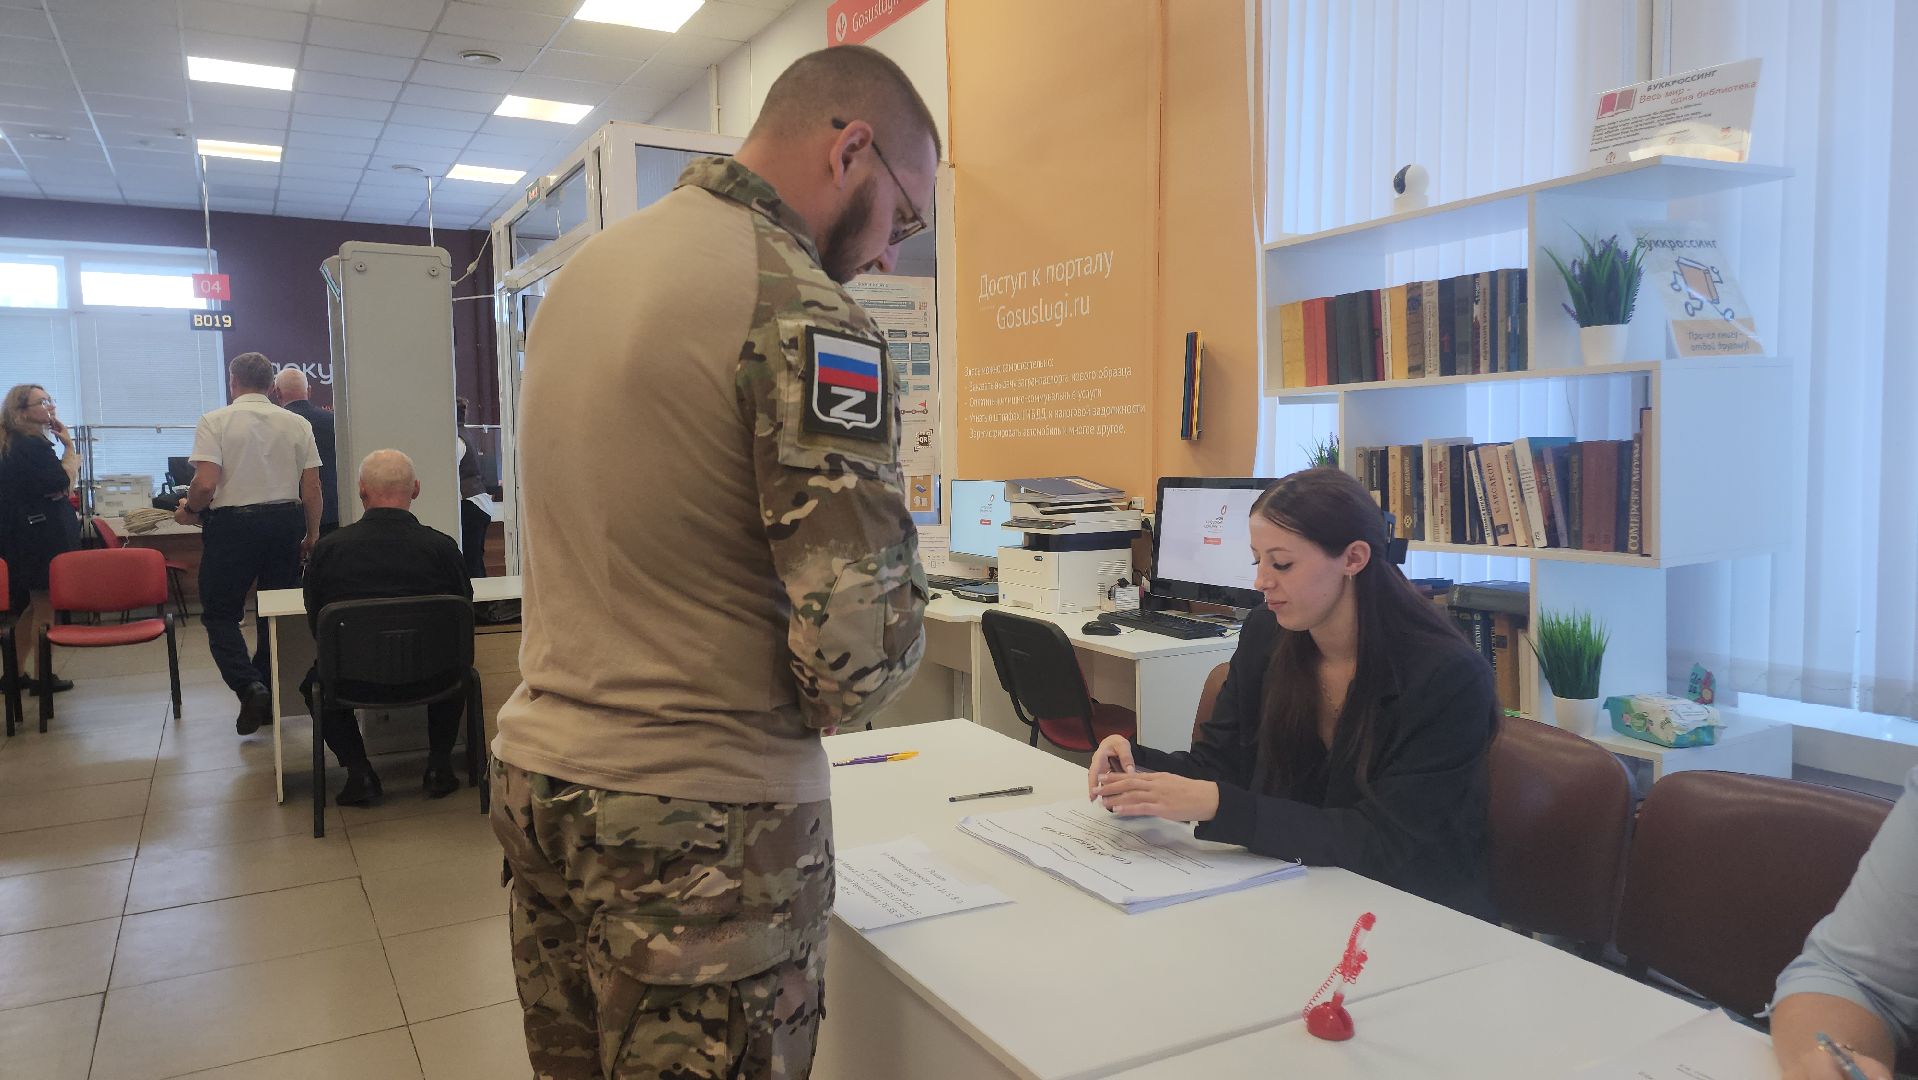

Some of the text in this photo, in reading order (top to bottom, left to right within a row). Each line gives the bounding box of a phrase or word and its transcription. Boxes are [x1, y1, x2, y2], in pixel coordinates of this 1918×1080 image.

[1646, 69, 1718, 92] БУККРОССИНГ
[1639, 93, 1662, 104] Весь
[1664, 88, 1685, 100] мир
[1670, 81, 1757, 105] одна библиотека
[979, 250, 1114, 303] Доступ к порталу
[200, 280, 221, 294] 04
[996, 292, 1090, 330] Gosuslugi.ru
[1072, 370, 1097, 382] нового
[1098, 366, 1132, 381] образца
[1078, 388, 1102, 402] услуги
[830, 386, 866, 423] Z
[1069, 425, 1095, 436] многое
[919, 435, 929, 444] QR
